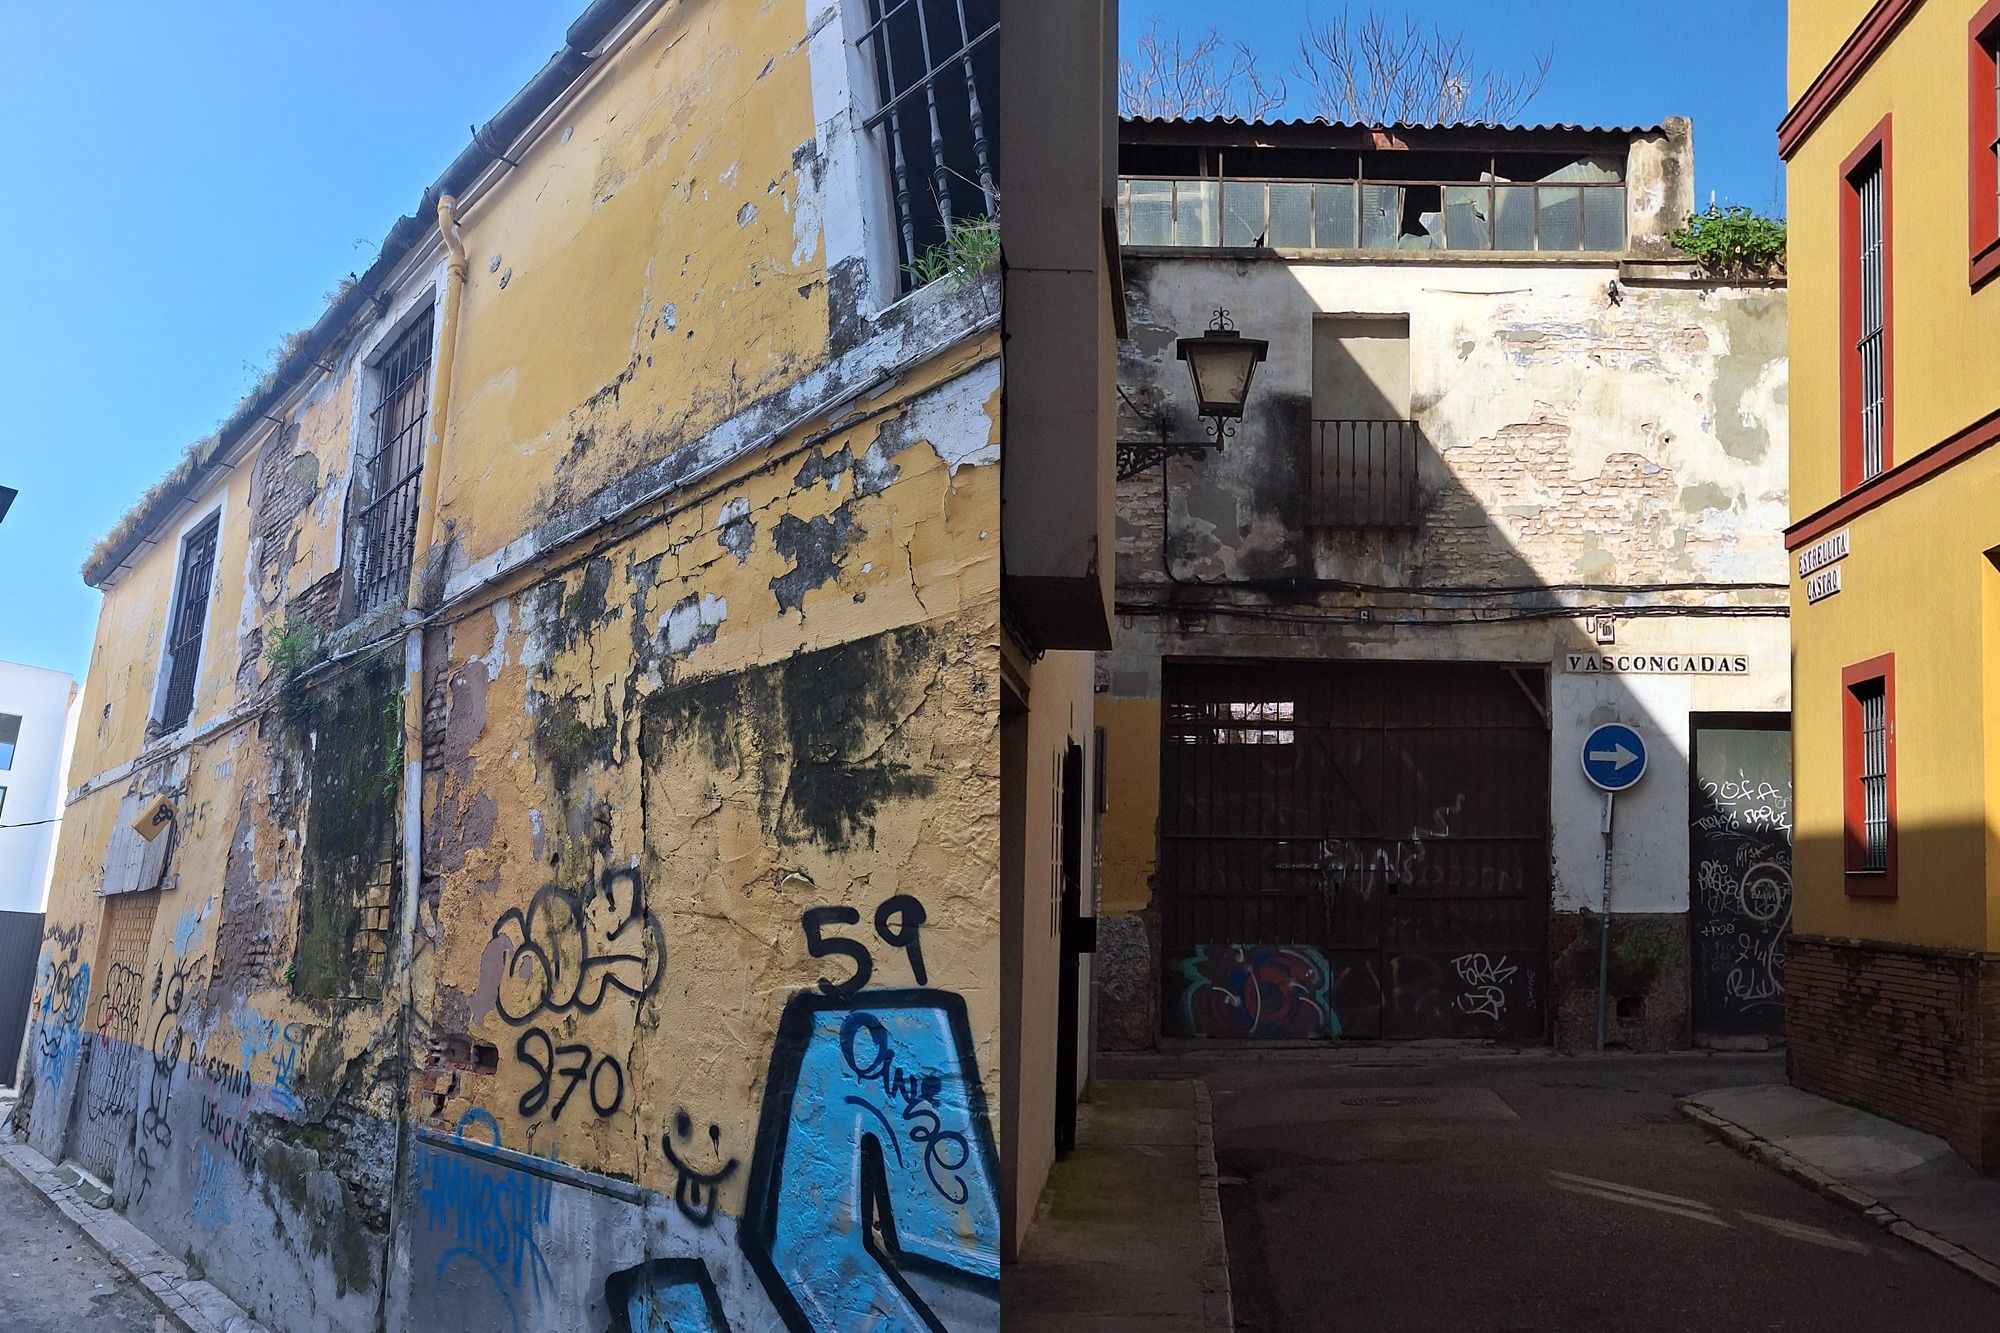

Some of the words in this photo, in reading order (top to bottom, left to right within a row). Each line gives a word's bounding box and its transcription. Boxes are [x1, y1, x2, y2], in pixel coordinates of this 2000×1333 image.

[1798, 533, 1847, 575] ESTRELLITA
[1807, 570, 1838, 600] CASTRO
[1569, 656, 1747, 672] VASCONGADAS
[801, 894, 927, 999] 59
[517, 1027, 624, 1122] 870
